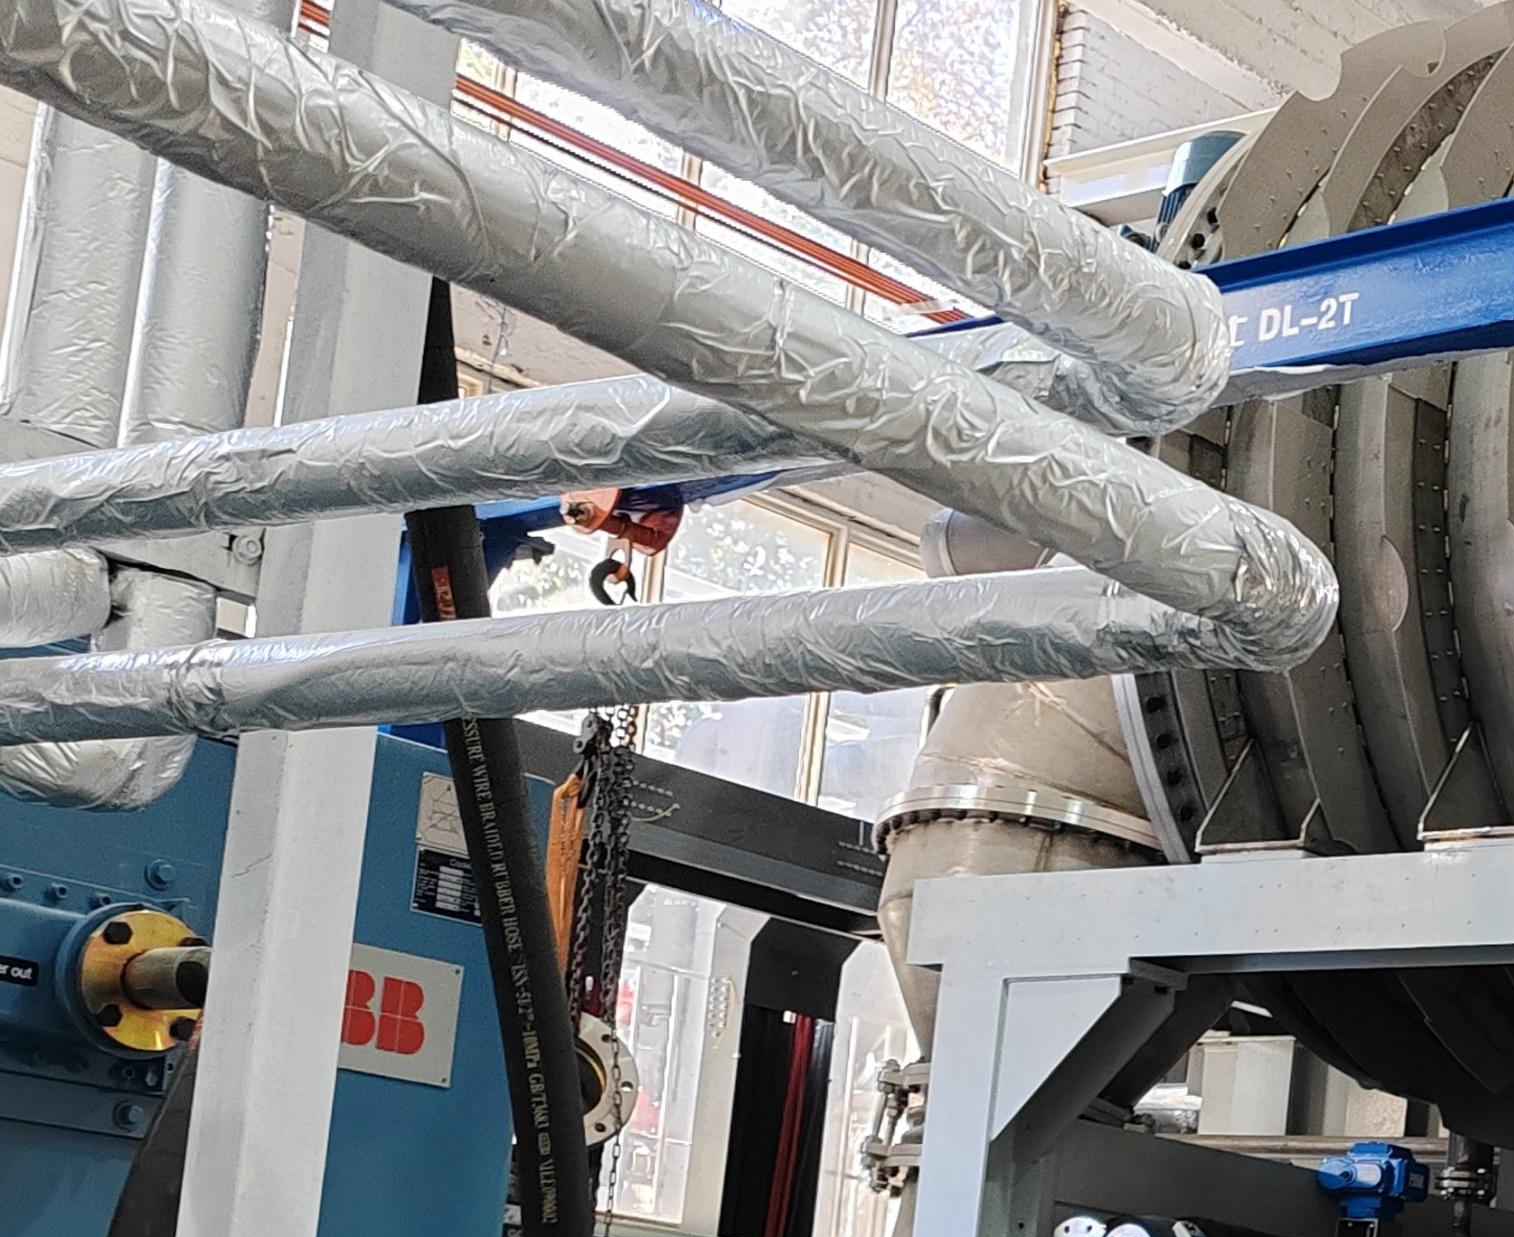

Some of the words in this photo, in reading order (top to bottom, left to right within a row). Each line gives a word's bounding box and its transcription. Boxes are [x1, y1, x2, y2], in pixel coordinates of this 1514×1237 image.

[1258, 292, 1360, 342] DL-2T
[472, 763, 493, 801] WIRE
[490, 862, 517, 917] RUBBER
[502, 916, 524, 955] HOSE
[10, 966, 33, 980] out
